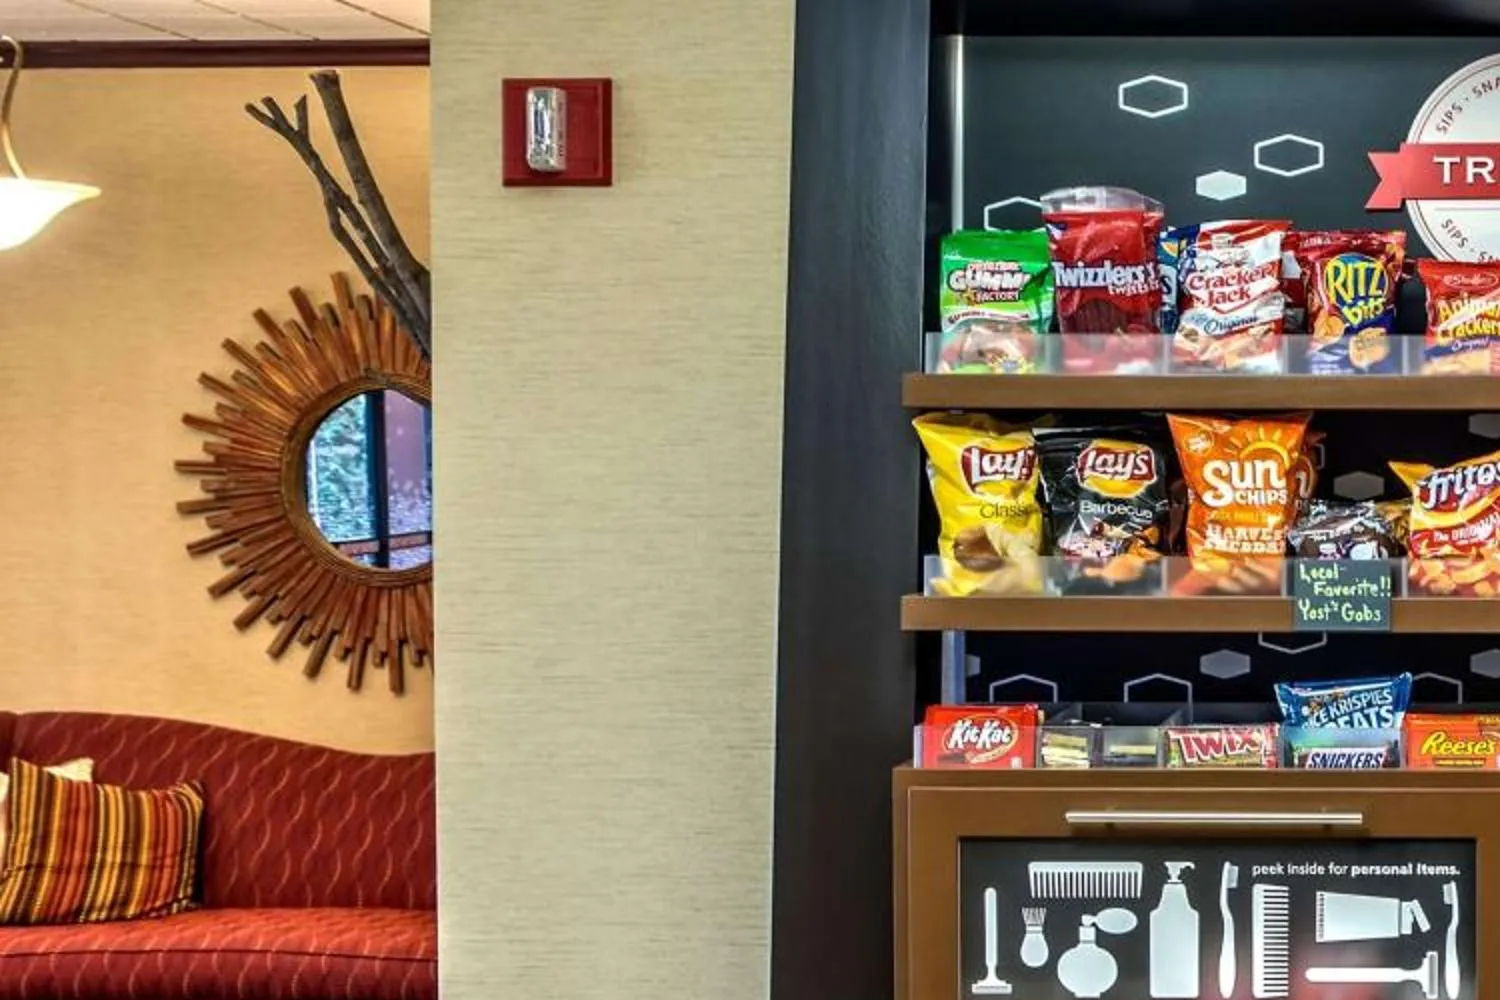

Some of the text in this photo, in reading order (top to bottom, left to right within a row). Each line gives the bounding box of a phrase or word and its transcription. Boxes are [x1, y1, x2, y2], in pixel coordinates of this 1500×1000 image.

[1436, 103, 1464, 134] SIPS
[1440, 218, 1469, 249] SIPS
[1189, 263, 1273, 291] Cracker
[1328, 260, 1385, 301] RITZ
[1203, 458, 1287, 508] Sun
[1234, 488, 1289, 506] CHIPS
[1079, 500, 1154, 520] Barbecue
[1299, 561, 1339, 584] Local
[1328, 687, 1393, 720] KRISPIES
[1174, 729, 1263, 763] TWIX
[1309, 751, 1385, 769] SNICKERS
[1252, 861, 1461, 878] peek inside for personal items.
